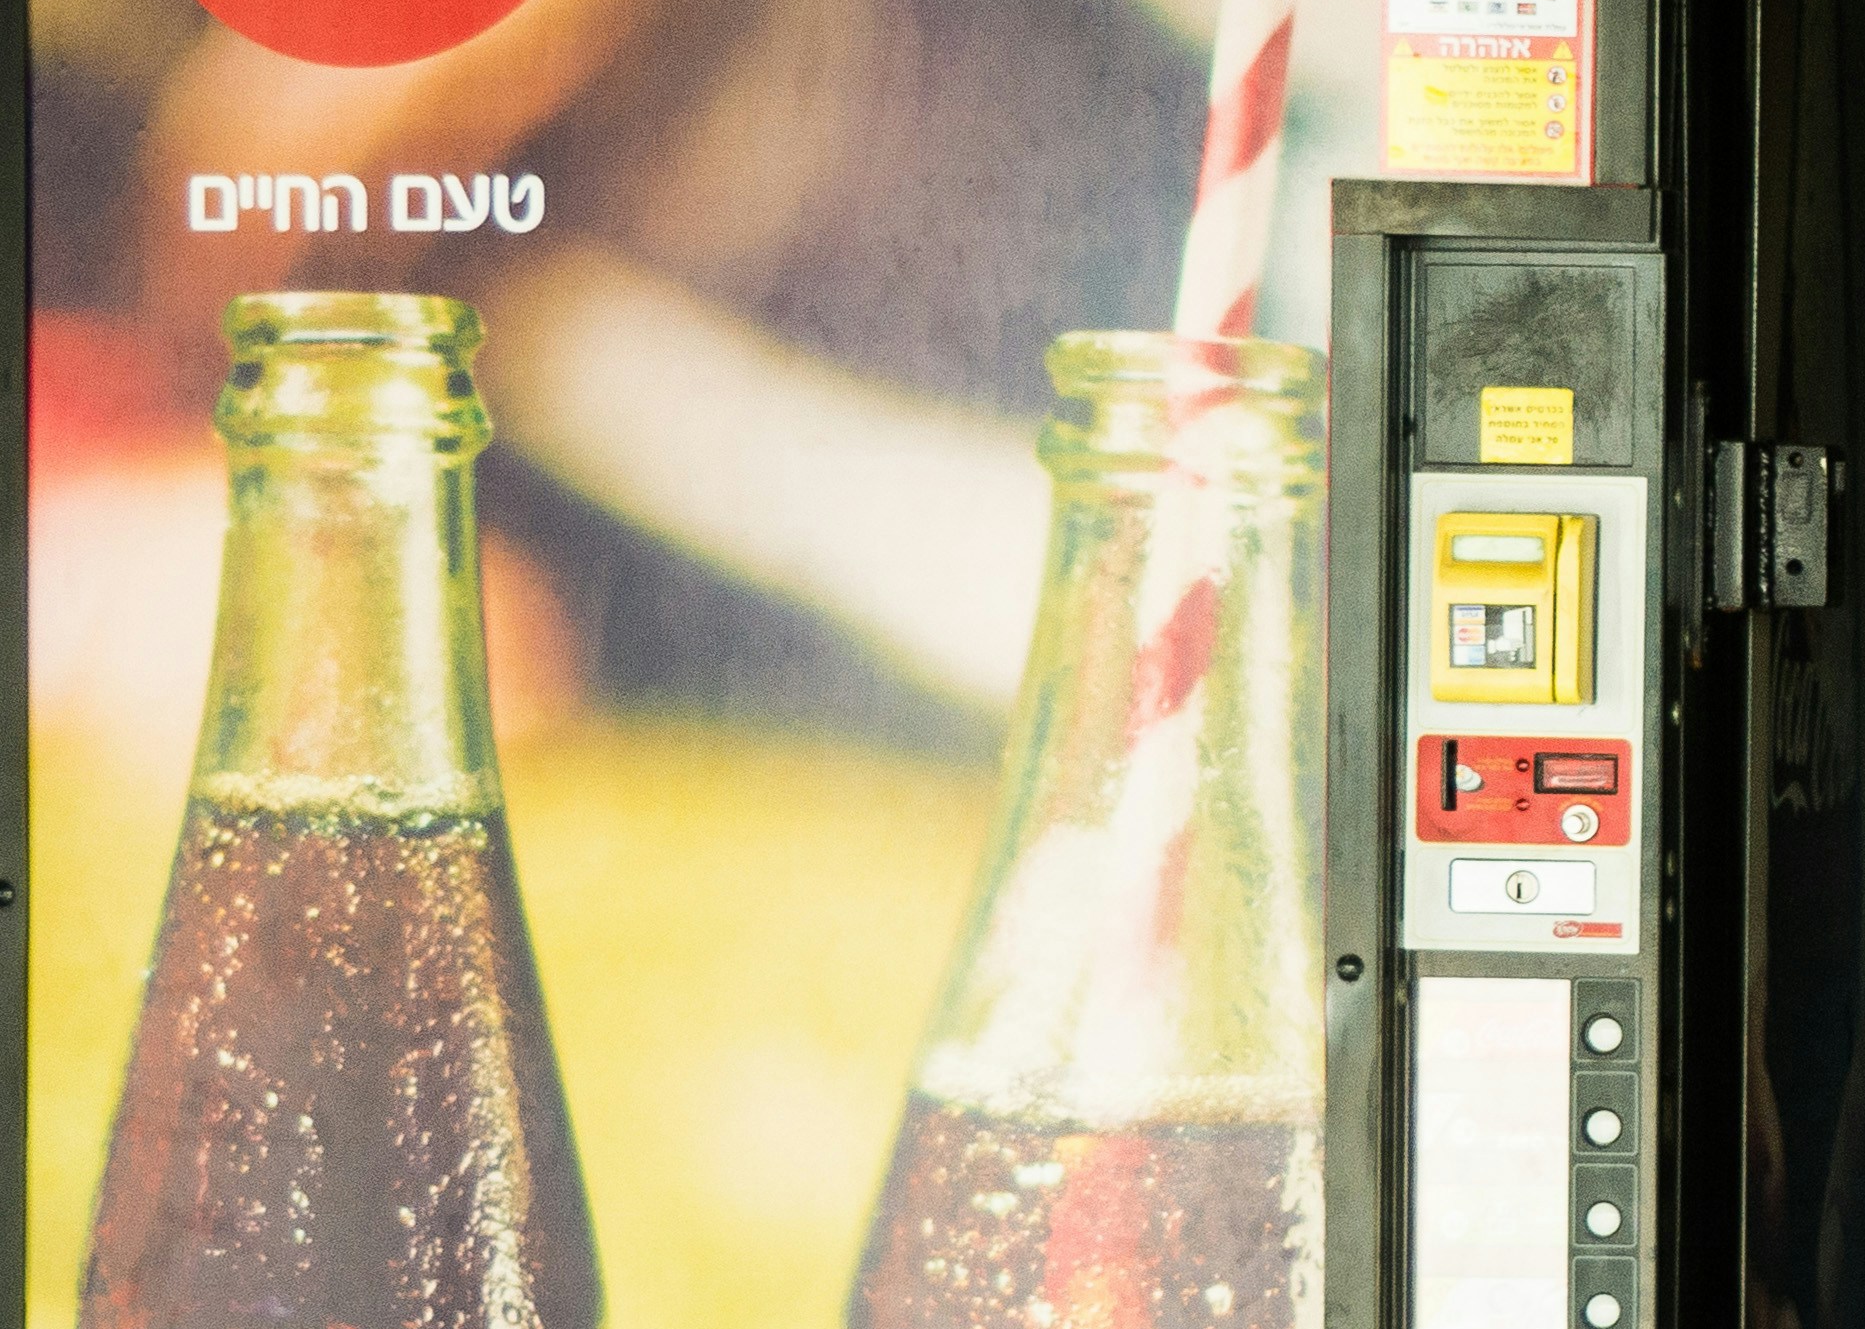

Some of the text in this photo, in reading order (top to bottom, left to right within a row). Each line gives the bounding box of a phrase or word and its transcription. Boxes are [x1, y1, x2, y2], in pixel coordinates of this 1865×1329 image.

[1438, 36, 1532, 58] אזהרה
[189, 172, 546, 234] טעם החיים
